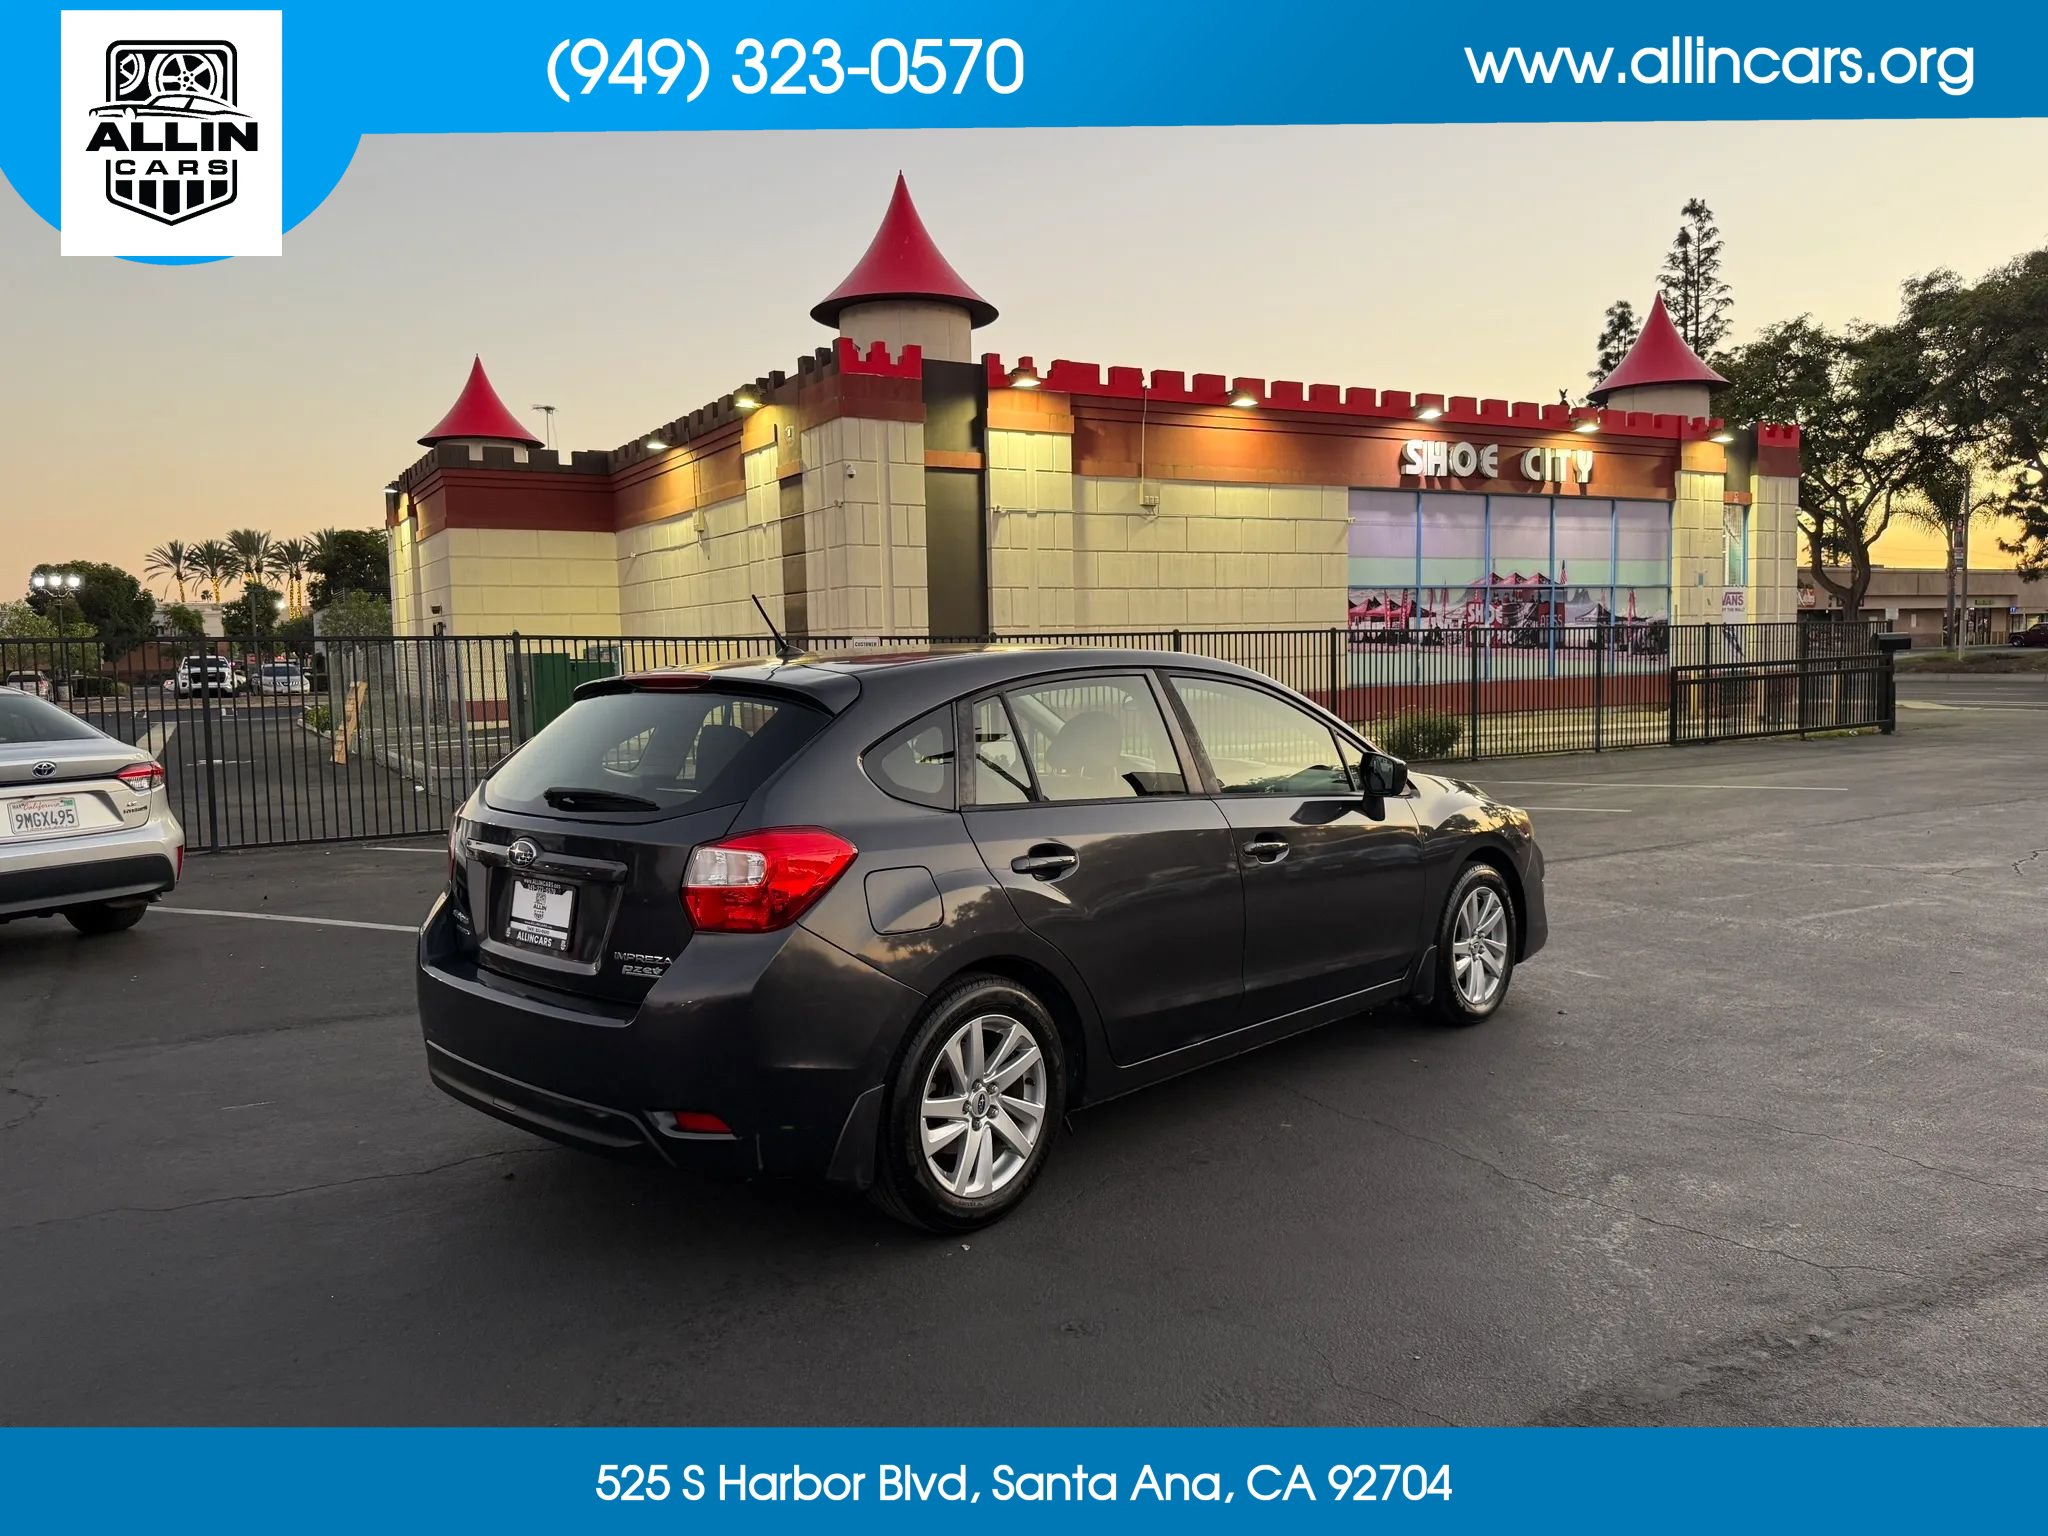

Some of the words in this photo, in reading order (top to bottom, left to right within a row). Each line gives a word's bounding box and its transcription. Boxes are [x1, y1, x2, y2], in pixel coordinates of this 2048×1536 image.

[1401, 439, 1499, 478] SHOE
[1520, 447, 1593, 483] CITY
[15, 809, 75, 829] 9MGX495
[516, 930, 553, 947] ALLINCARS
[614, 951, 673, 965] IMPREZA
